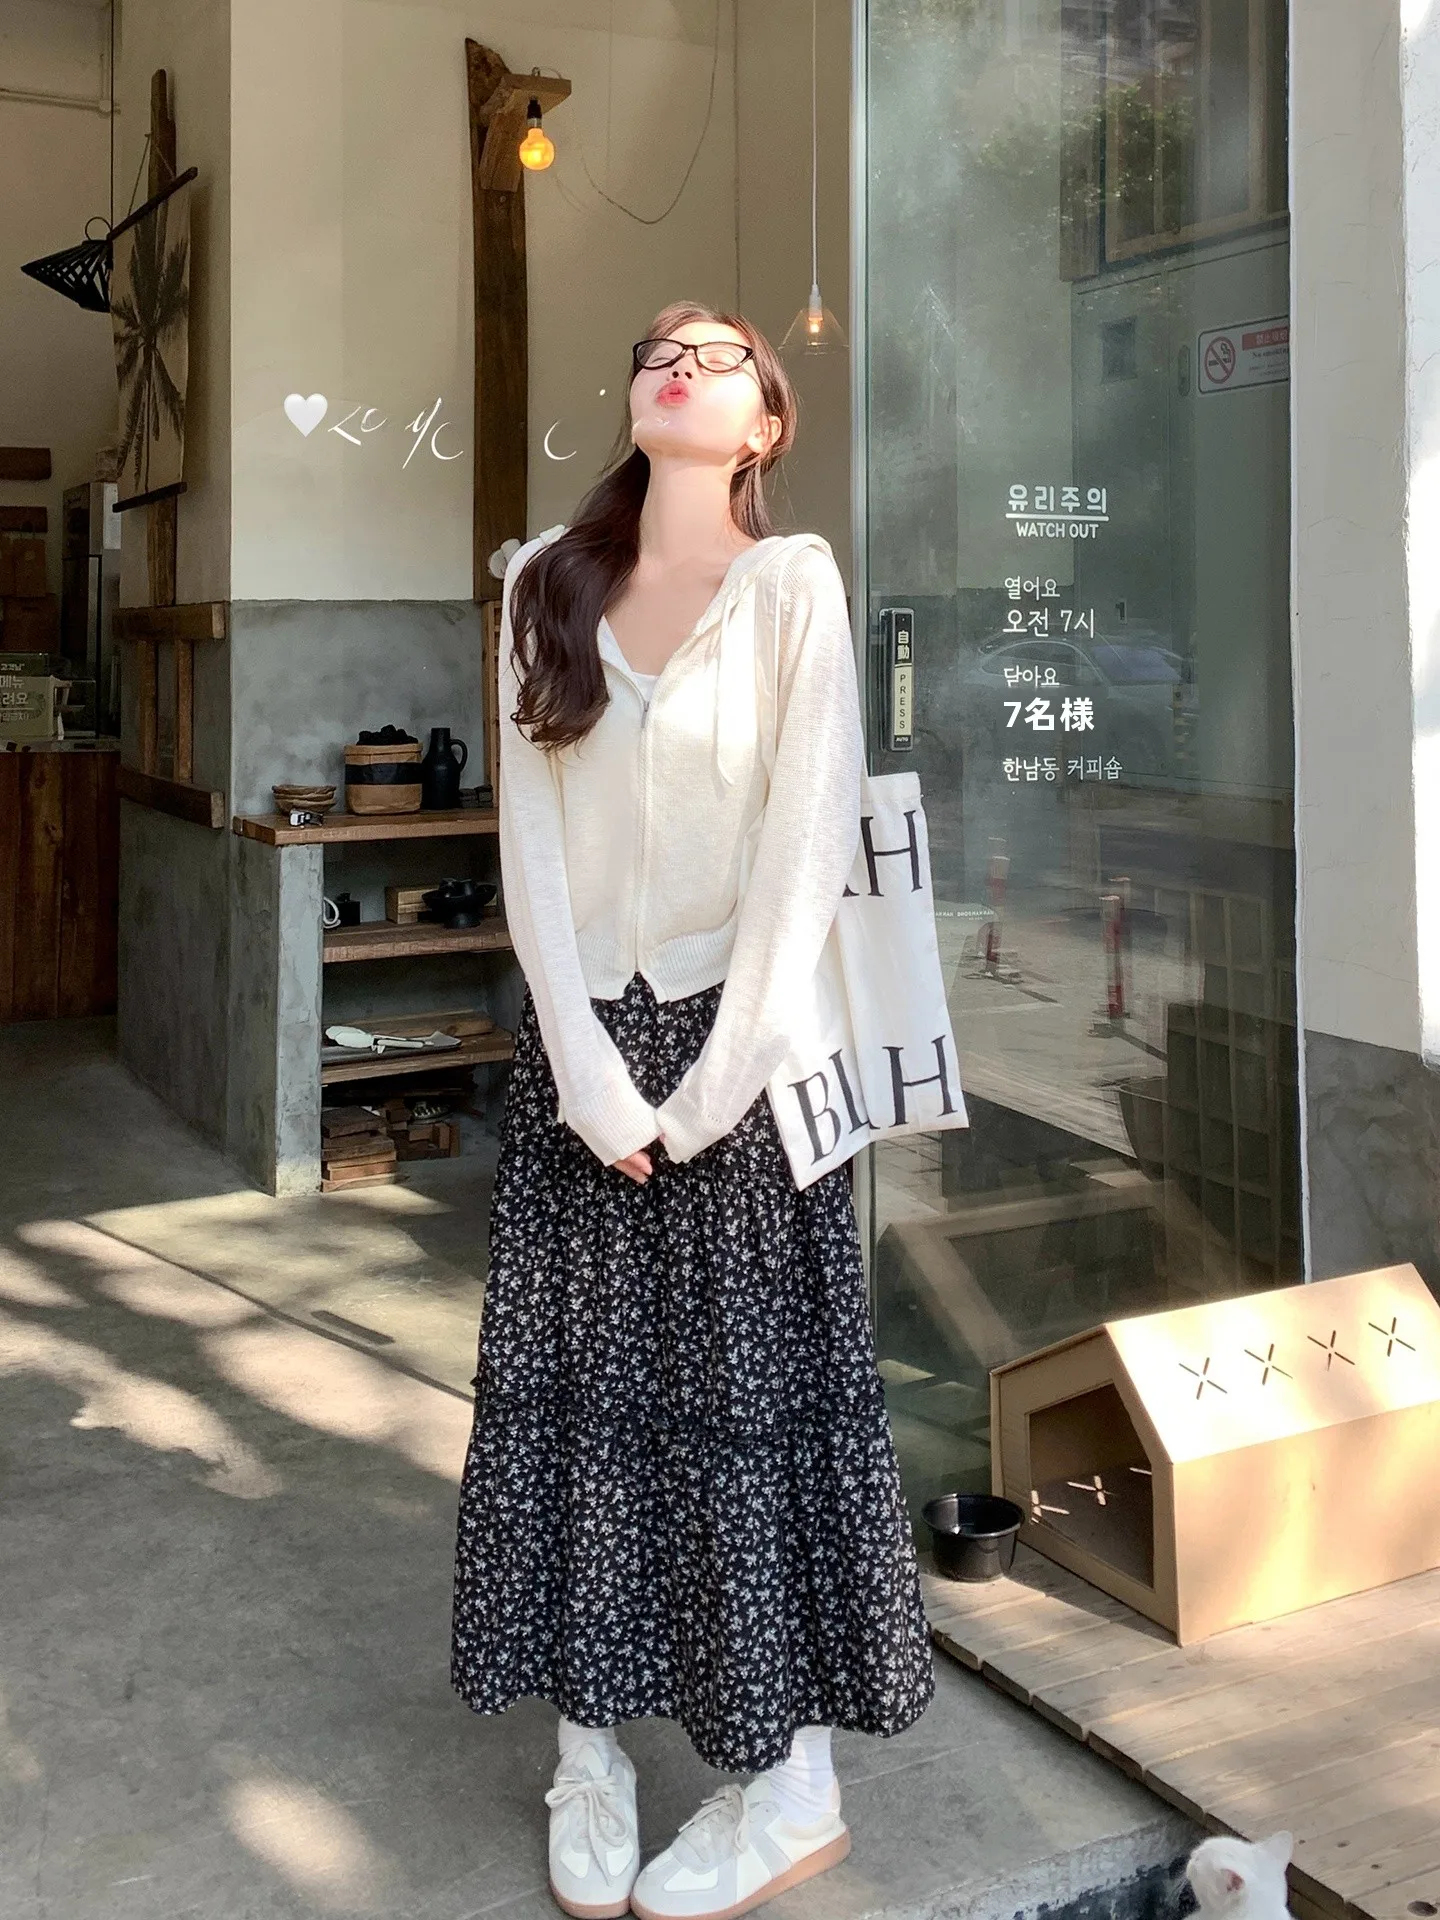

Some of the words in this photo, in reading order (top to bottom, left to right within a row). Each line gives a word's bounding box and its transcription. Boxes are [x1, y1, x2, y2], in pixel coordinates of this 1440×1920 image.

[1008, 484, 1107, 514] 유리주의
[1016, 521, 1066, 538] WATCH
[1069, 523, 1099, 539] OUT
[1004, 575, 1060, 601] 열어요
[1002, 607, 1049, 637] 오전
[1060, 608, 1094, 639] 7시
[897, 630, 910, 660] 自動
[1003, 665, 1060, 688] 닫아요
[0, 692, 29, 705] 려요
[1003, 697, 1095, 732] 7名様
[1003, 757, 1060, 781] 한남동
[1067, 756, 1123, 781] 커피숍
[787, 1035, 958, 1166] BLH
